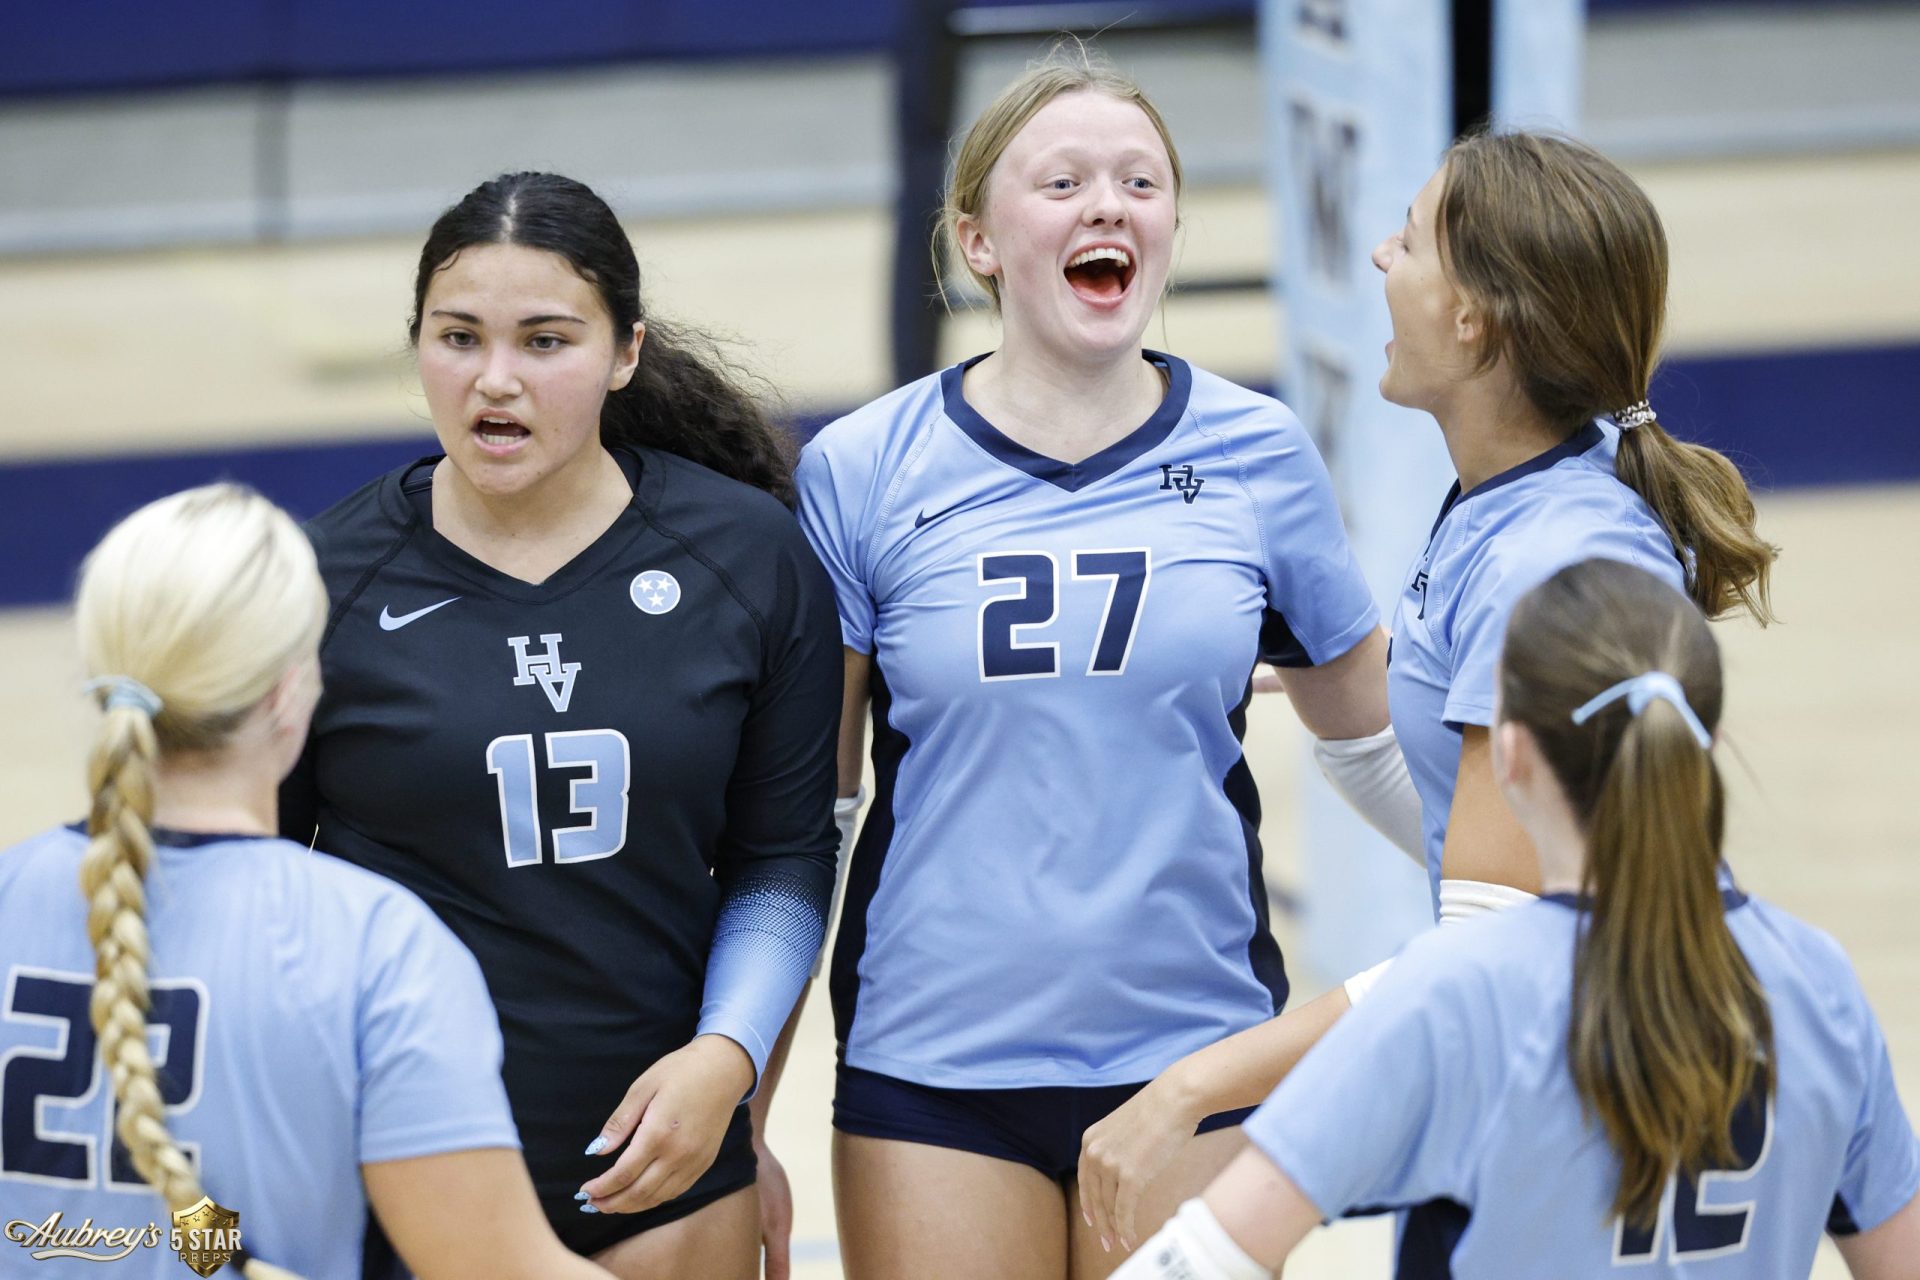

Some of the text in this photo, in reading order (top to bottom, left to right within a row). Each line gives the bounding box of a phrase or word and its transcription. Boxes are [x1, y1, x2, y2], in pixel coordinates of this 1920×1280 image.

[507, 633, 582, 712] HV
[977, 547, 1151, 683] 27
[486, 728, 631, 868] 13
